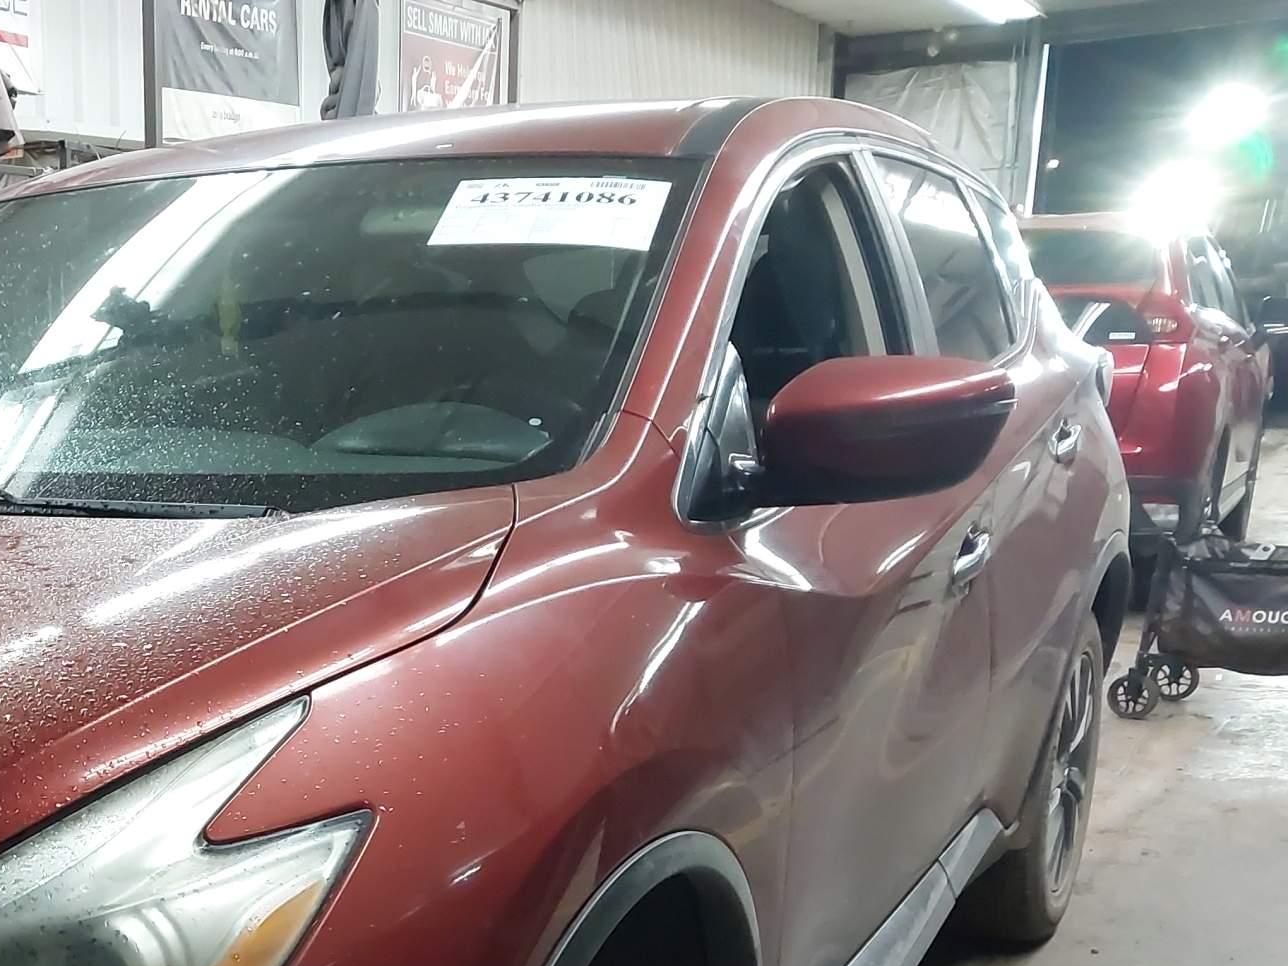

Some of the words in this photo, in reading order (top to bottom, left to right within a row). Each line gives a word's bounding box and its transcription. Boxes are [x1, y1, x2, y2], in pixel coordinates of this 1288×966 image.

[180, 0, 236, 26] RENTAL
[240, 3, 278, 34] CARS
[407, 5, 428, 32] SELL
[428, 11, 459, 39] SMART
[470, 190, 637, 206] 43741086
